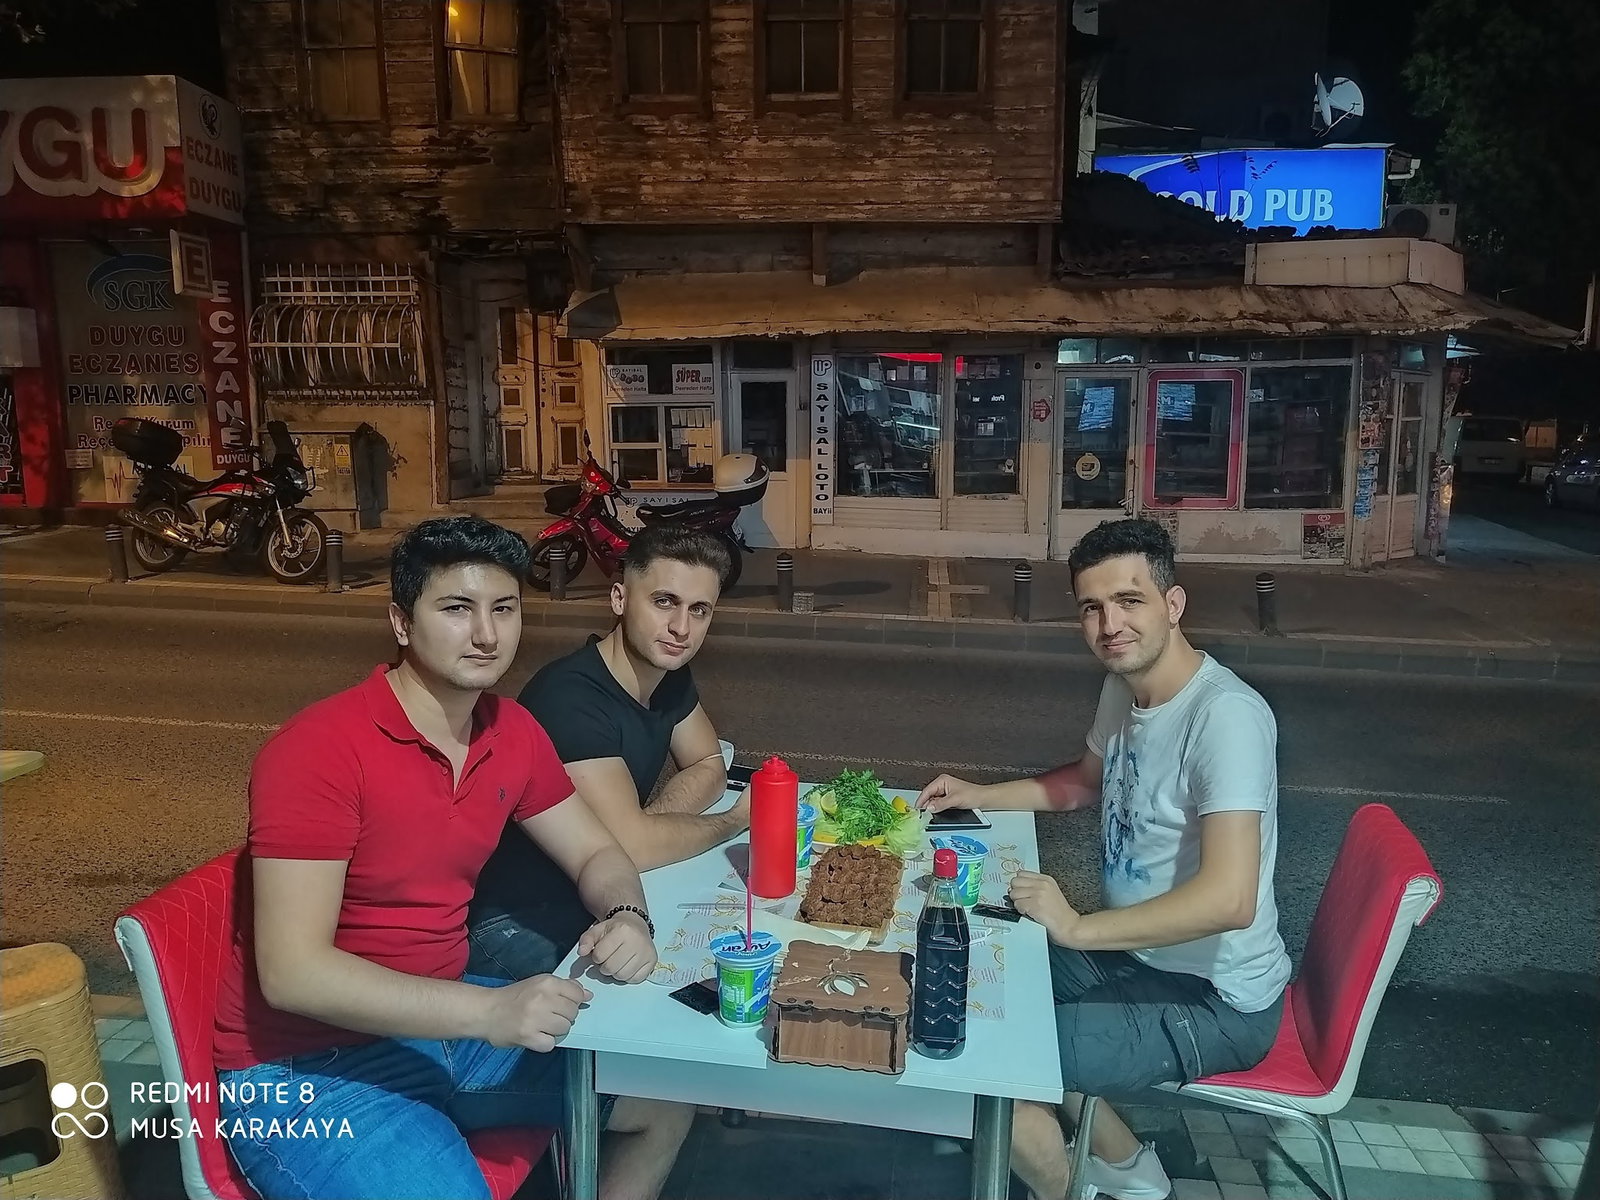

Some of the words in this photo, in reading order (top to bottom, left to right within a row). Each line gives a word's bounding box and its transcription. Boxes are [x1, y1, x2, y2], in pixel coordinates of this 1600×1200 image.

[187, 136, 238, 177] ECZANE
[189, 176, 242, 214] DUYGU
[1264, 188, 1334, 222] PUB
[103, 280, 174, 312] SGK
[89, 326, 185, 348] DUYGU
[208, 280, 246, 450] ECZANE
[816, 382, 829, 456] SAYISAL
[217, 455, 250, 464] DUYGU
[816, 463, 829, 501] LOTO
